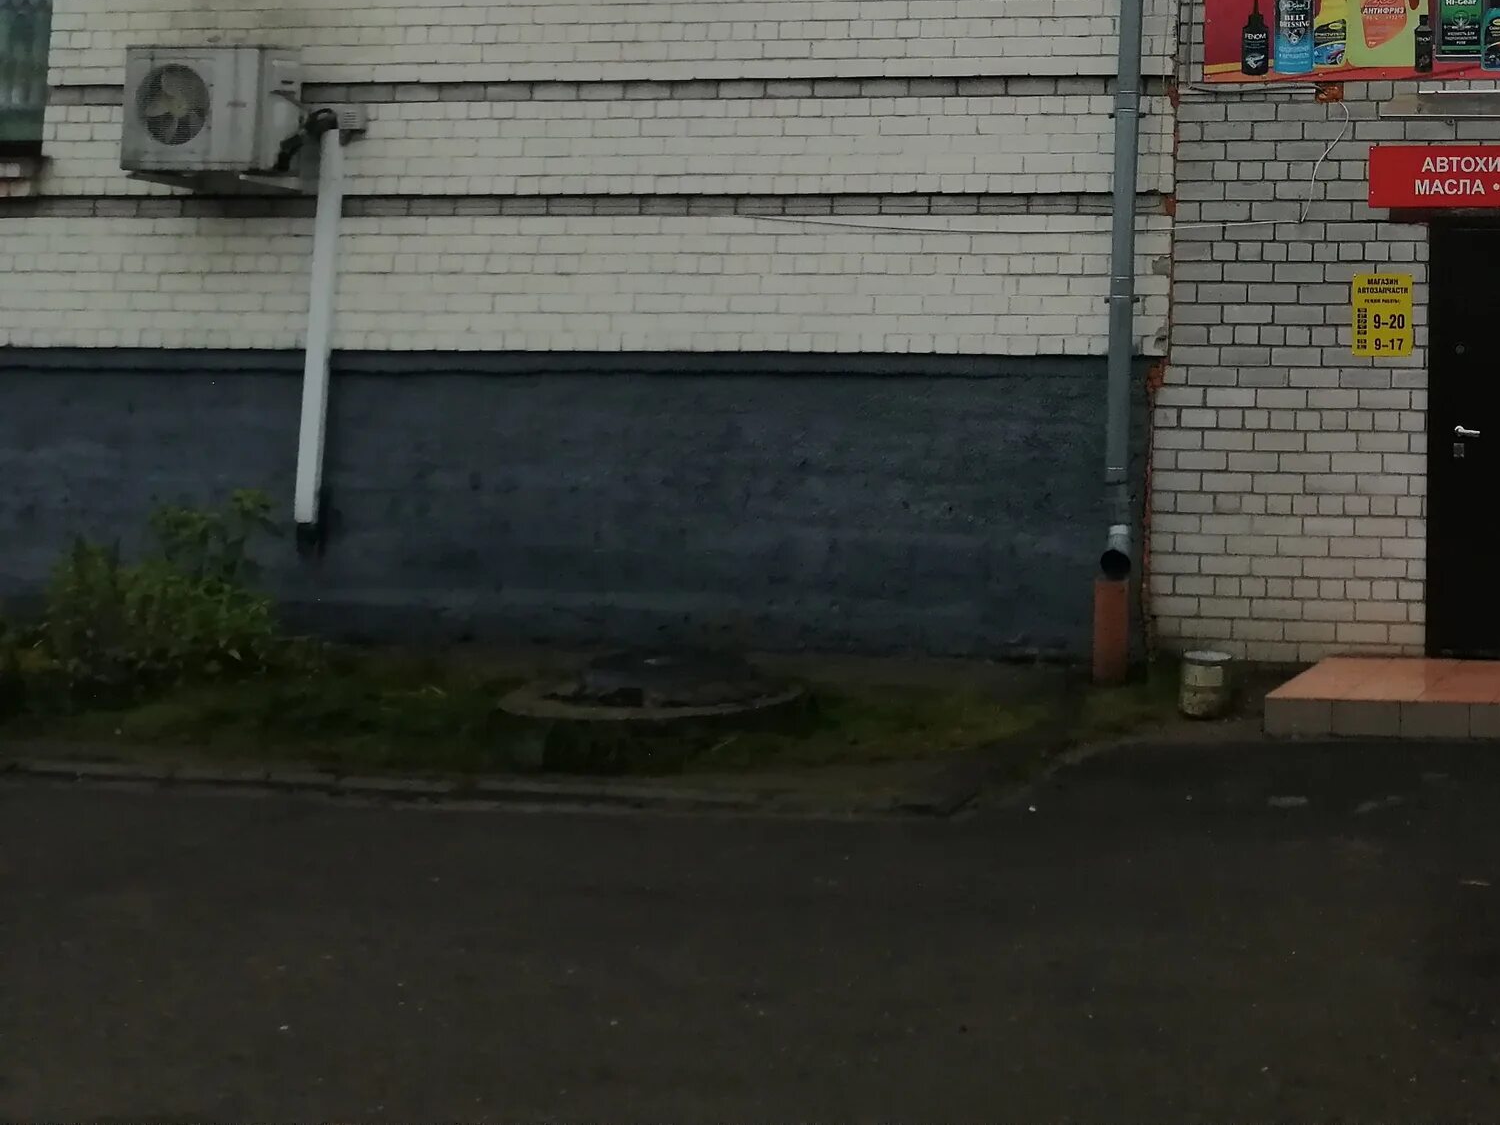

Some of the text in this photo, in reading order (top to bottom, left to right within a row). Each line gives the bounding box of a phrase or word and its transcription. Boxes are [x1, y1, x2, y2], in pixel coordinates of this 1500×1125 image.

[1363, 7, 1405, 15] АНТИФРИЗ
[1279, 20, 1310, 28] DRESSING
[1414, 179, 1485, 195] МАСЛА
[1357, 286, 1409, 294] АВТОЗАПЧАСТИ
[1373, 313, 1405, 329] 9-20
[1374, 337, 1404, 351] 9-17
